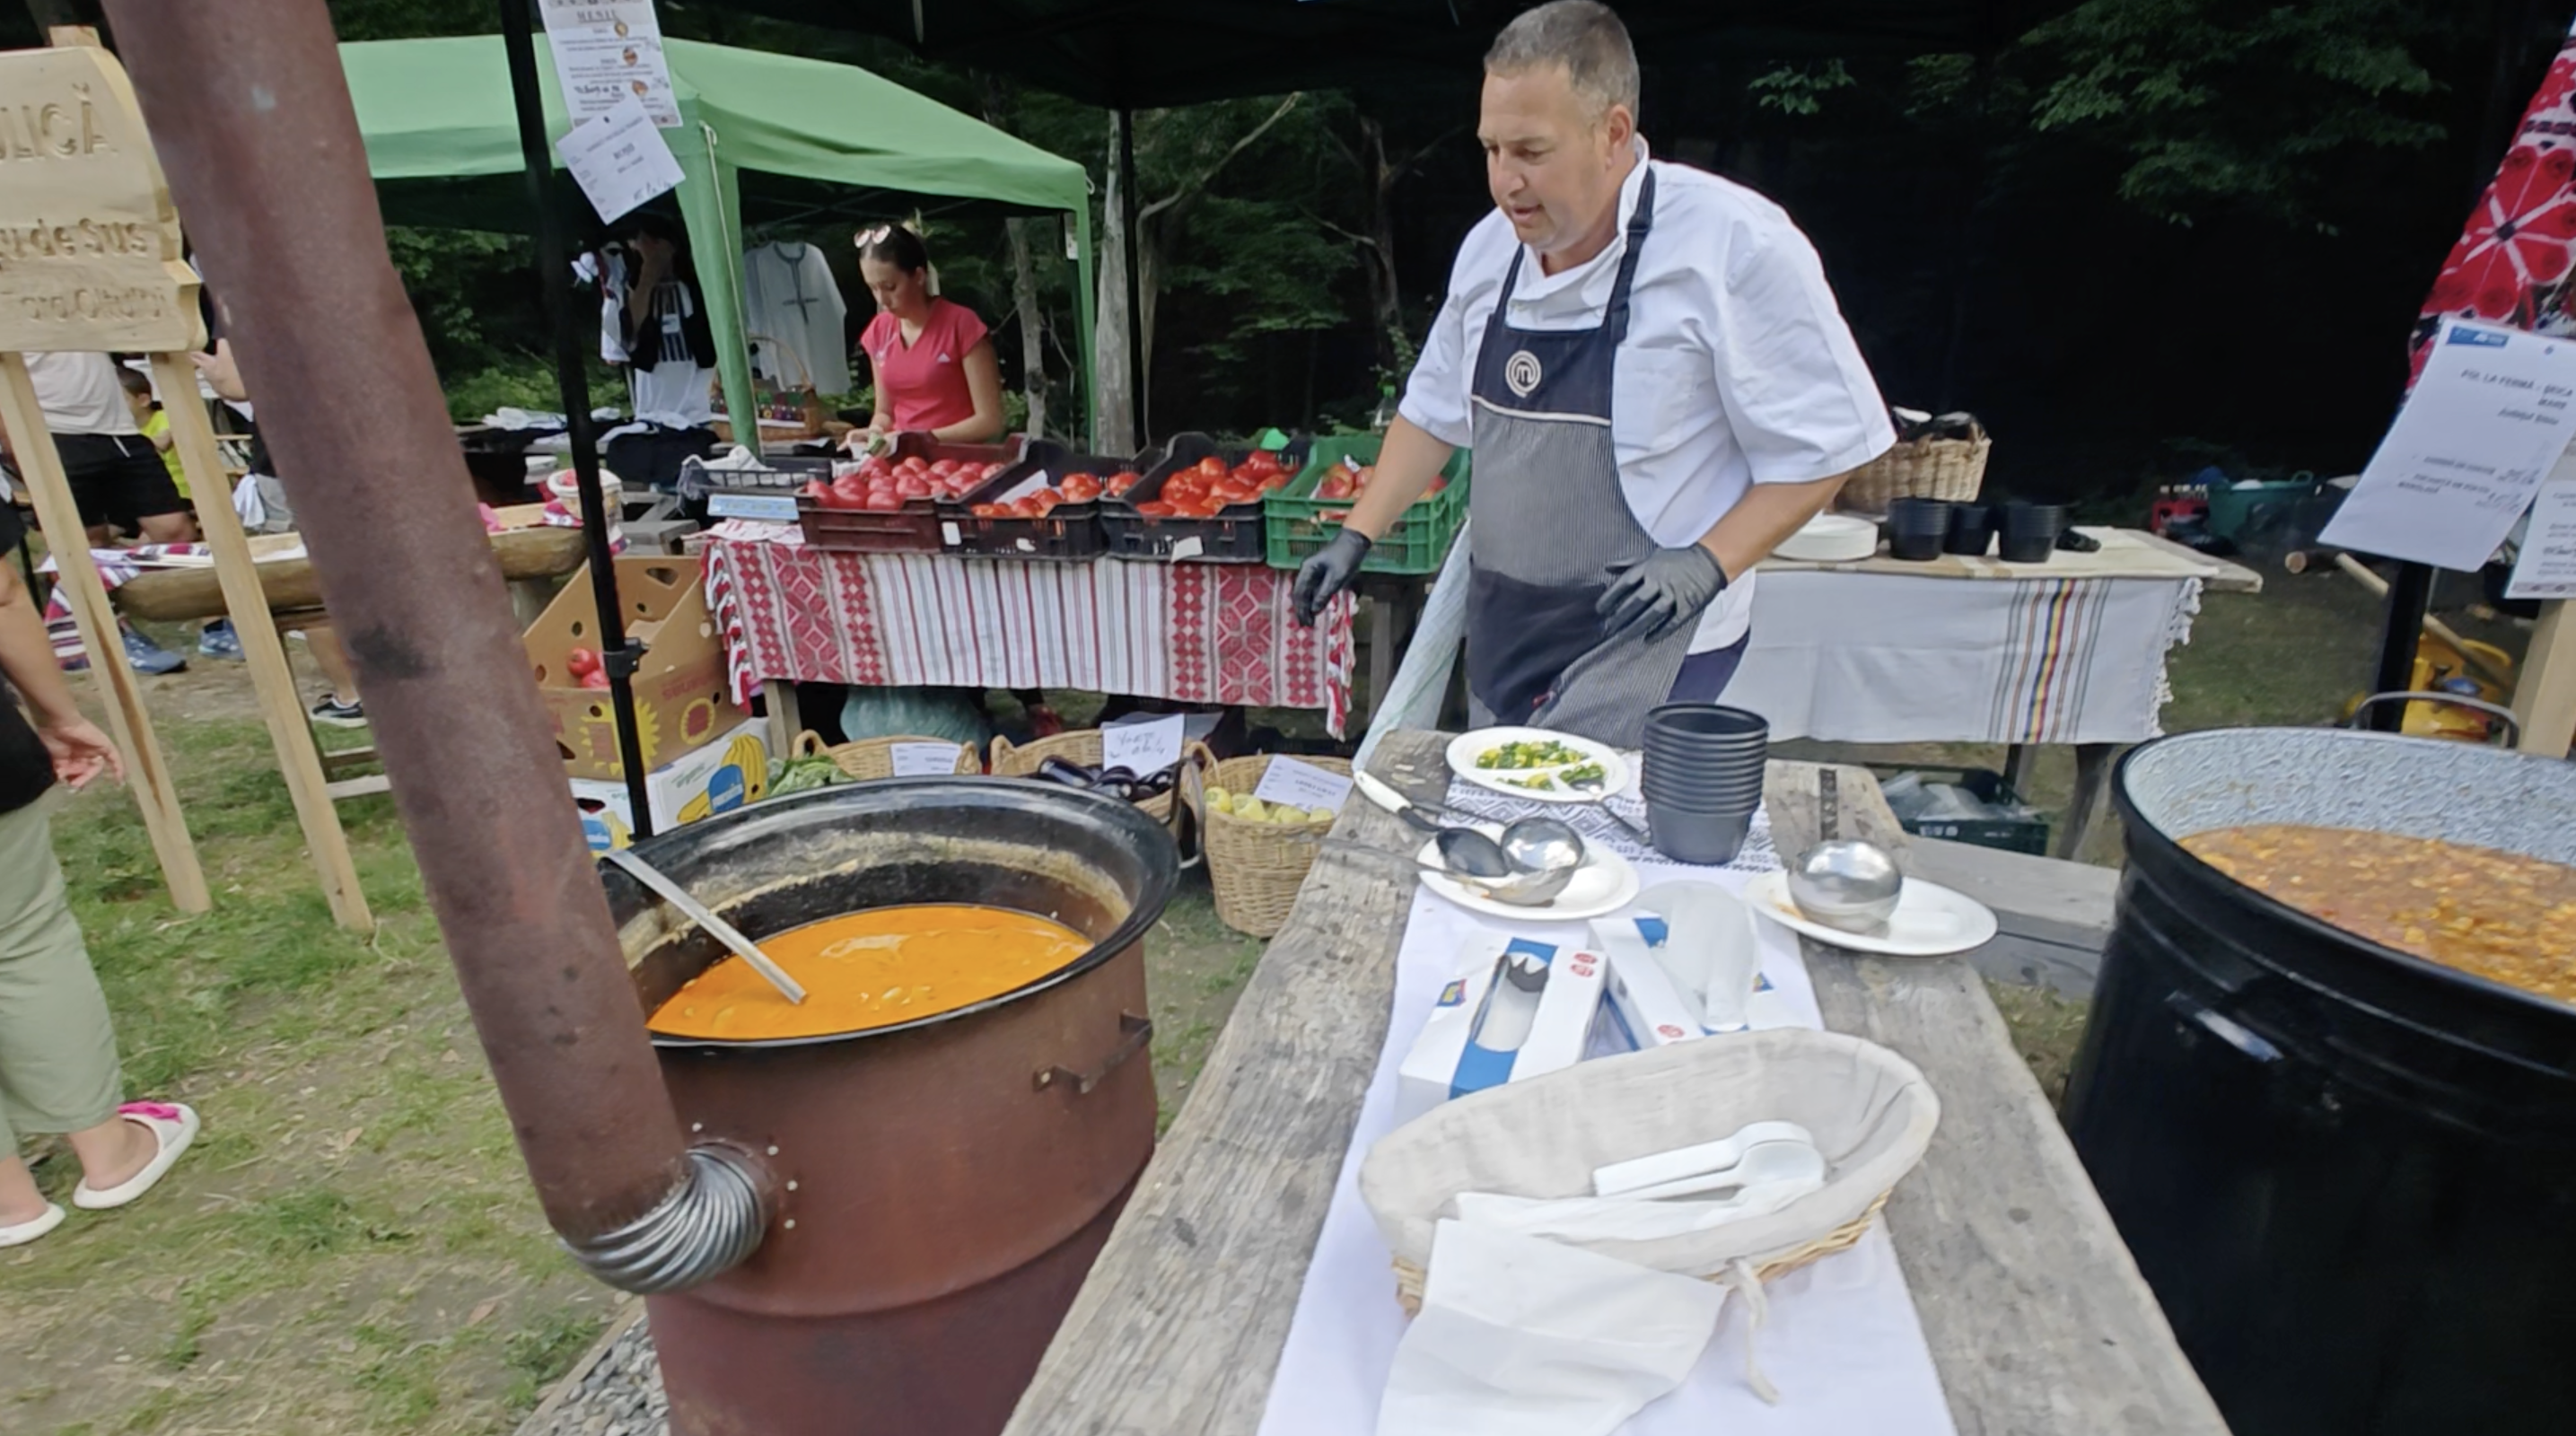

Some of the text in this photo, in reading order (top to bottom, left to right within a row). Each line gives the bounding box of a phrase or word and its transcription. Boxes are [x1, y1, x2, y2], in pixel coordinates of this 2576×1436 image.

[0, 82, 119, 160] LICĂ
[30, 218, 77, 257] de
[79, 217, 148, 256] Sus
